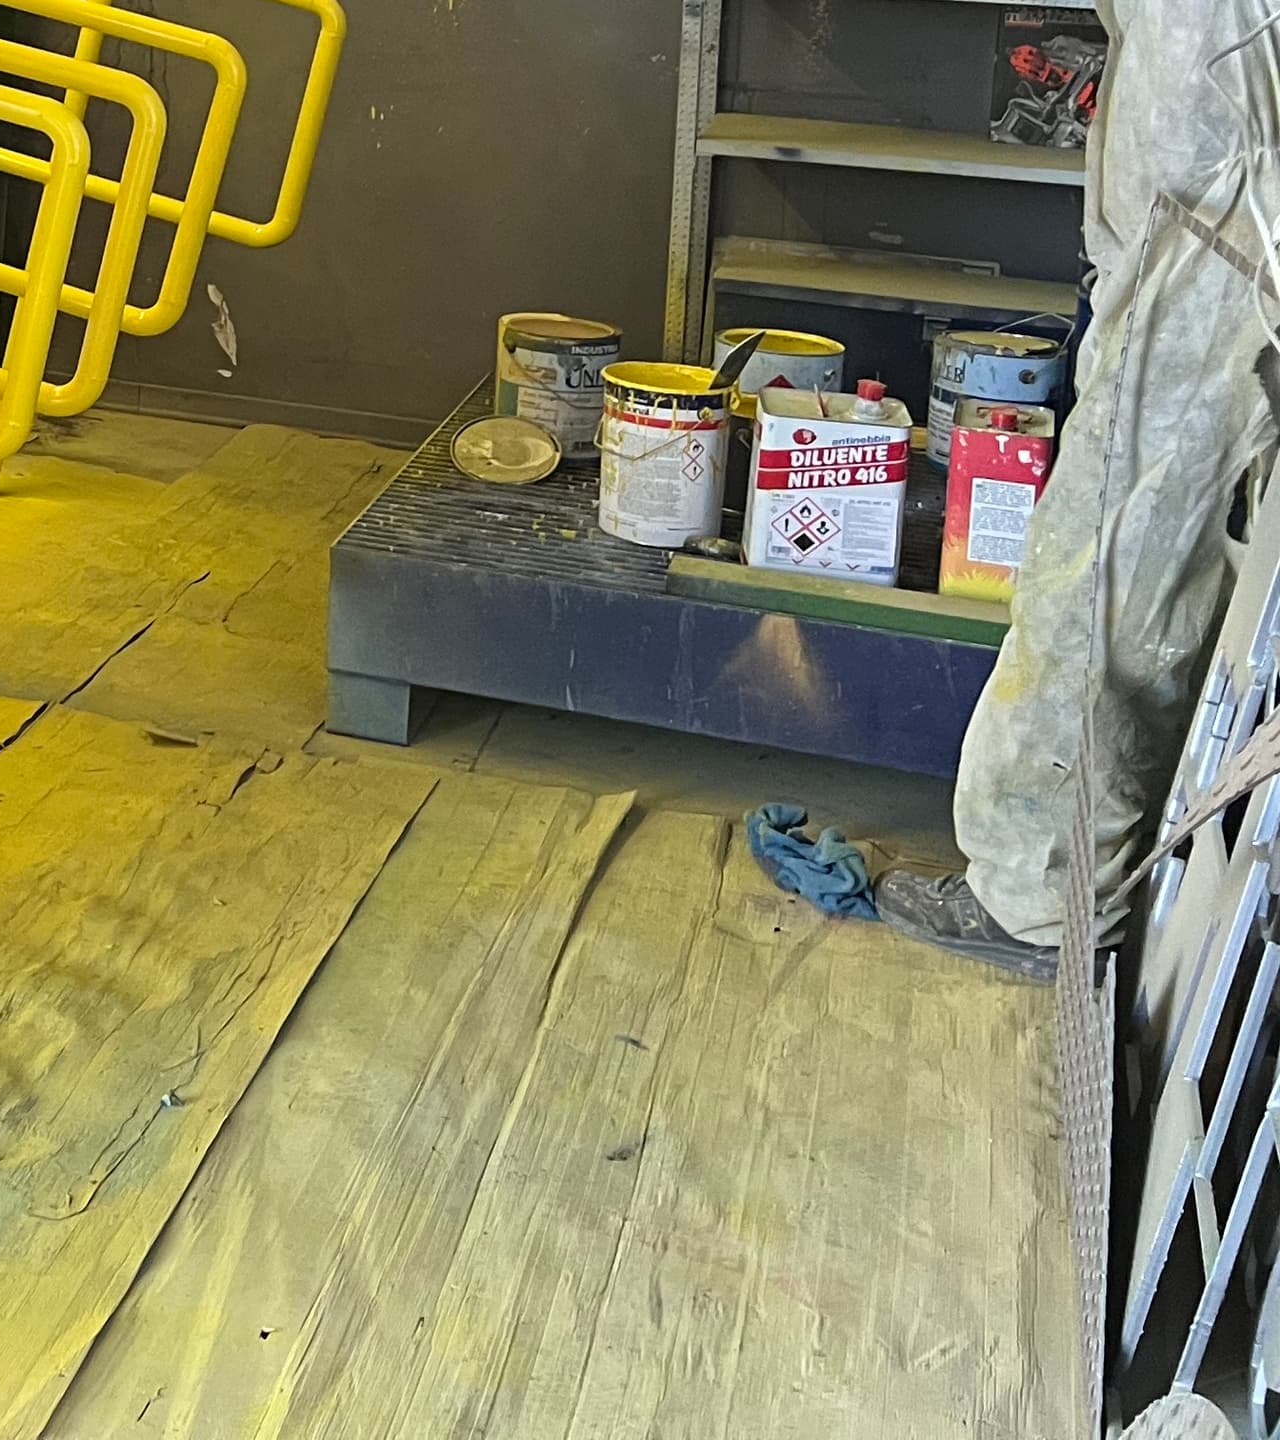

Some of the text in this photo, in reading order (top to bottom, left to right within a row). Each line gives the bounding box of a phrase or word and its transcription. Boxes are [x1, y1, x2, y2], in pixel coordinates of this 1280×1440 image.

[832, 435, 891, 446] antinebbia
[790, 445, 889, 467] DILUENTE
[788, 466, 888, 488] NITRO 416
